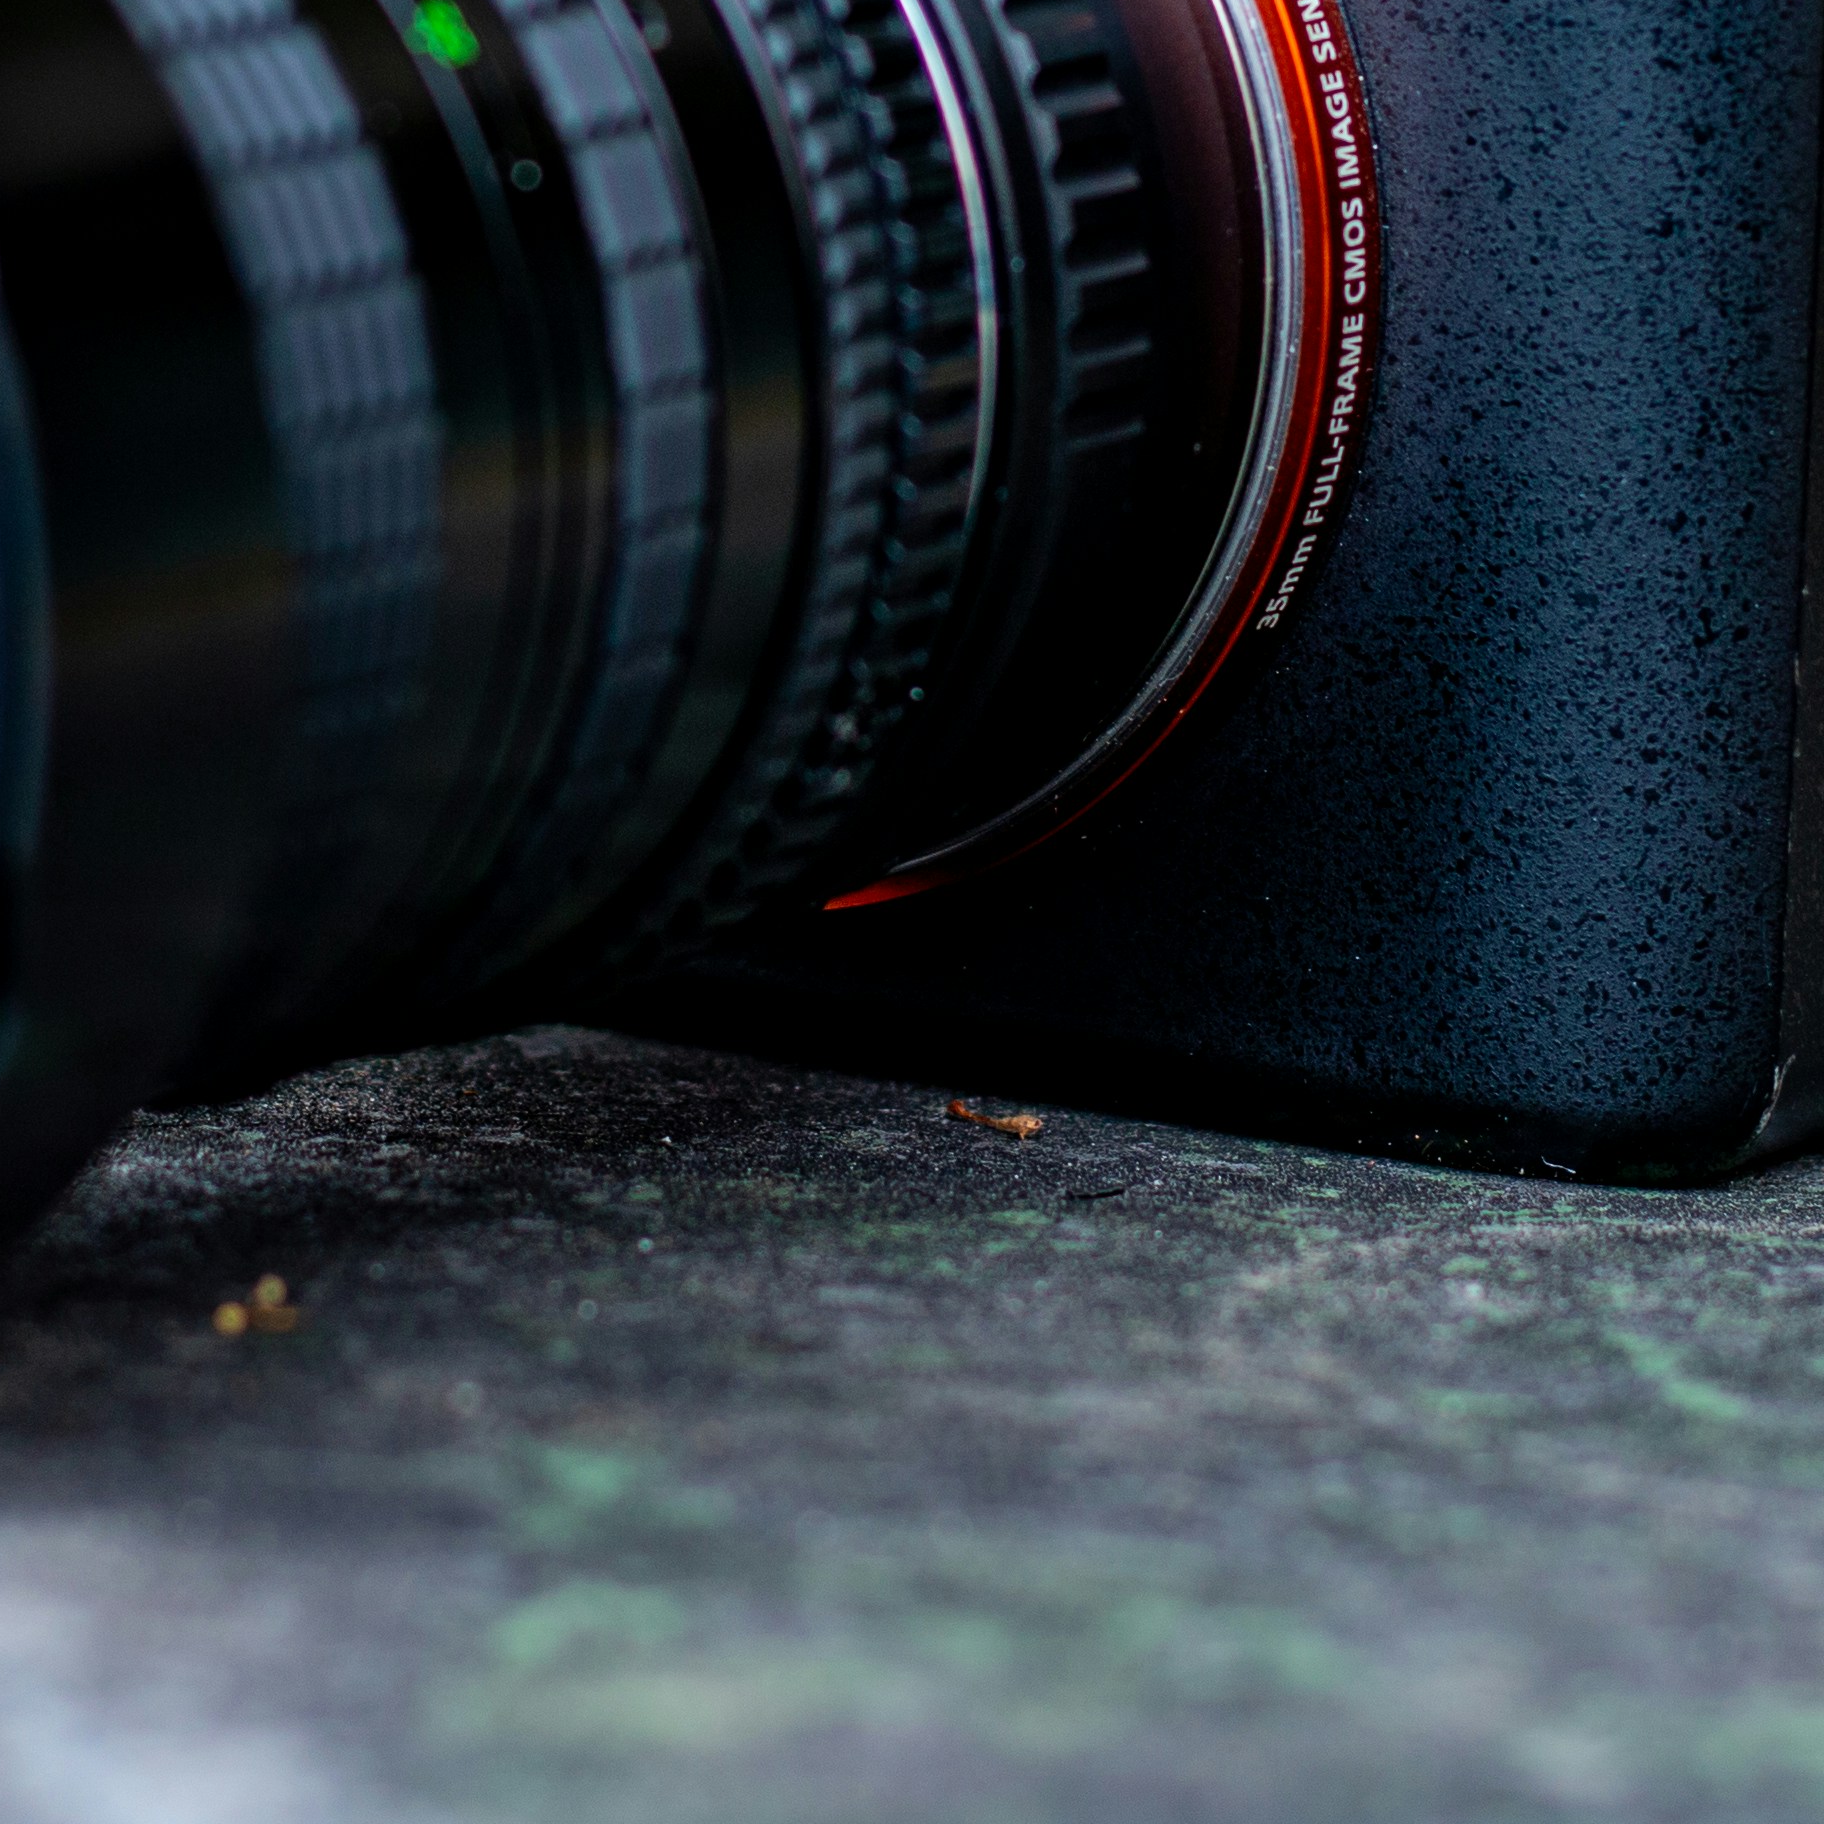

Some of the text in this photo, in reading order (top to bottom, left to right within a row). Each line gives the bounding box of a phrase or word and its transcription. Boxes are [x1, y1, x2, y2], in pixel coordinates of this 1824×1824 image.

[1320, 69, 1360, 189] IMAGE
[1341, 196, 1366, 305] CMOS
[1303, 312, 1364, 526] FULL-FRAME
[1256, 534, 1317, 631] 35mm
